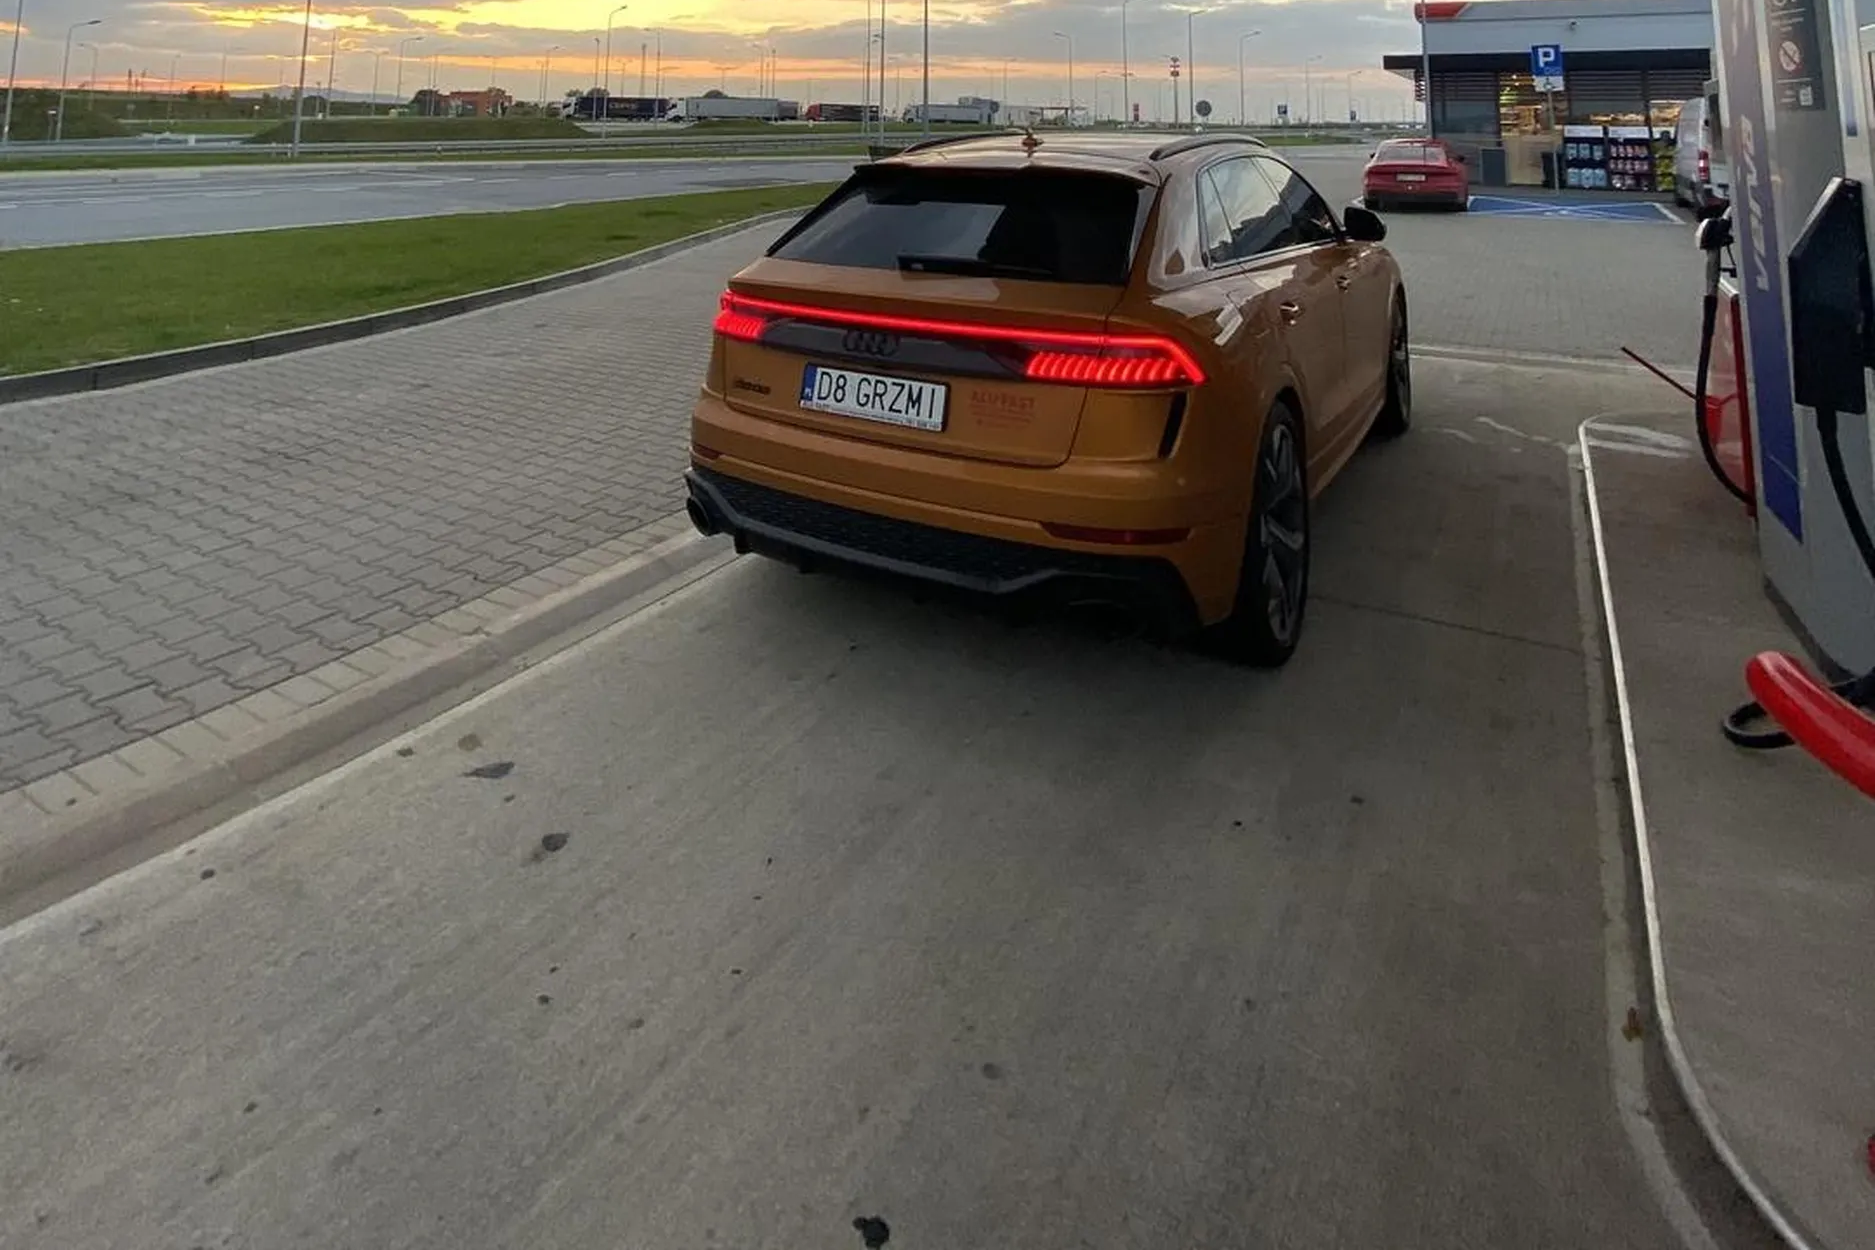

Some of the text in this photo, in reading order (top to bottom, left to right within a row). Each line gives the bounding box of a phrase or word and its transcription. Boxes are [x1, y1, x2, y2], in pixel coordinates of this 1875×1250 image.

[1537, 47, 1555, 68] P
[817, 371, 936, 420] D8 GRZMI
